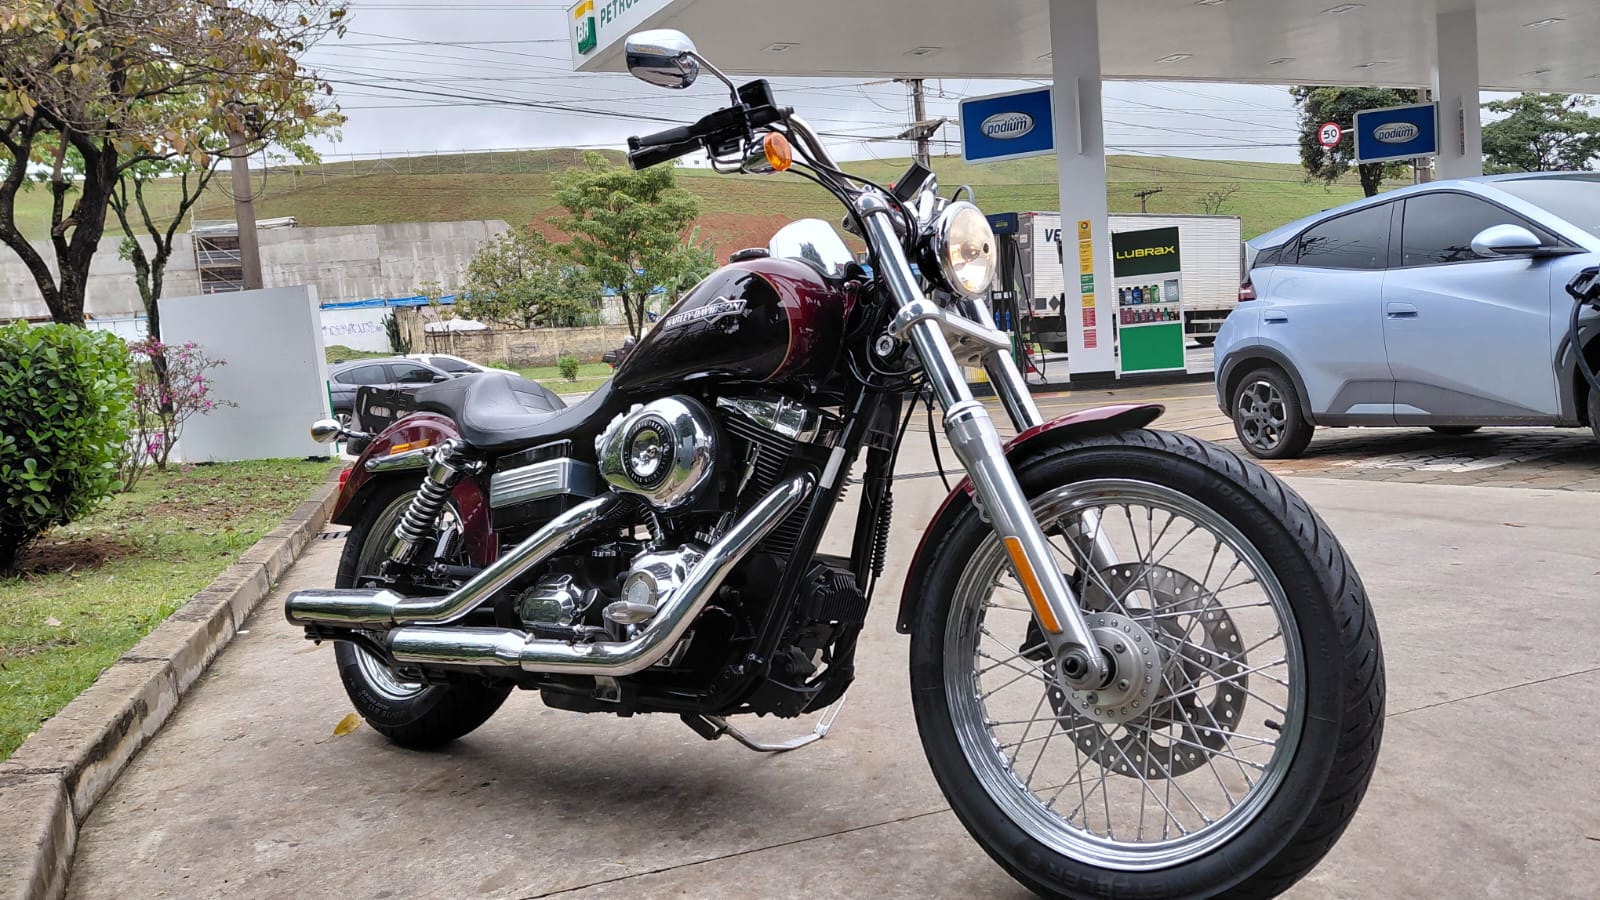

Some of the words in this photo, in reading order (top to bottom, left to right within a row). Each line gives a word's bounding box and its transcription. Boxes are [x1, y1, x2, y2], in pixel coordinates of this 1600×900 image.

[600, 0, 639, 28] PETRO
[986, 118, 1028, 137] podium
[1323, 129, 1337, 139] 50
[1378, 128, 1414, 140] podium
